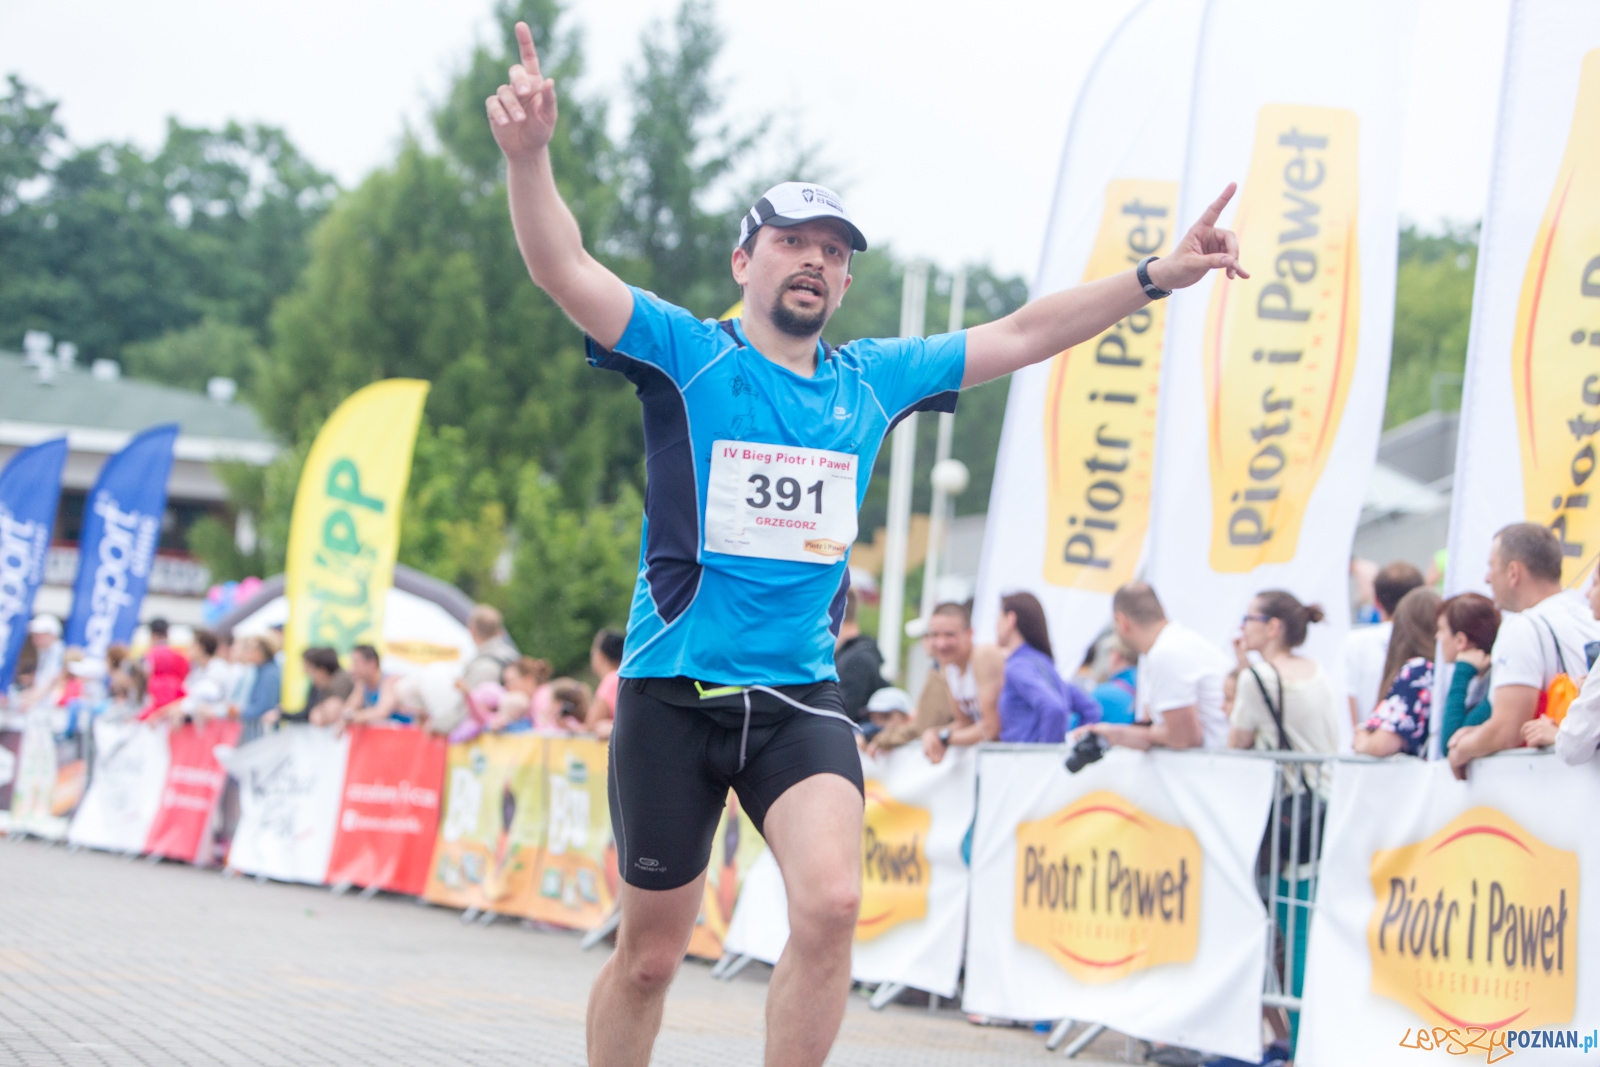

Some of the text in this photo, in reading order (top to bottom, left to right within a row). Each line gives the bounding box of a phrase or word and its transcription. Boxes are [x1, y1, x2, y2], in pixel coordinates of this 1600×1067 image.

[1096, 198, 1169, 368] Paeł
[1252, 349, 1304, 364] i
[1088, 392, 1138, 405] i
[723, 447, 851, 472] IV Bieg Piotr i Paweł
[1229, 387, 1294, 547] Piotr
[745, 473, 824, 515] 391
[755, 516, 817, 531] GRZEGORZ
[1063, 424, 1132, 570] Piotr
[1022, 845, 1189, 924] Piotr i Paweł
[1378, 876, 1568, 973] Piotr i Paweł
